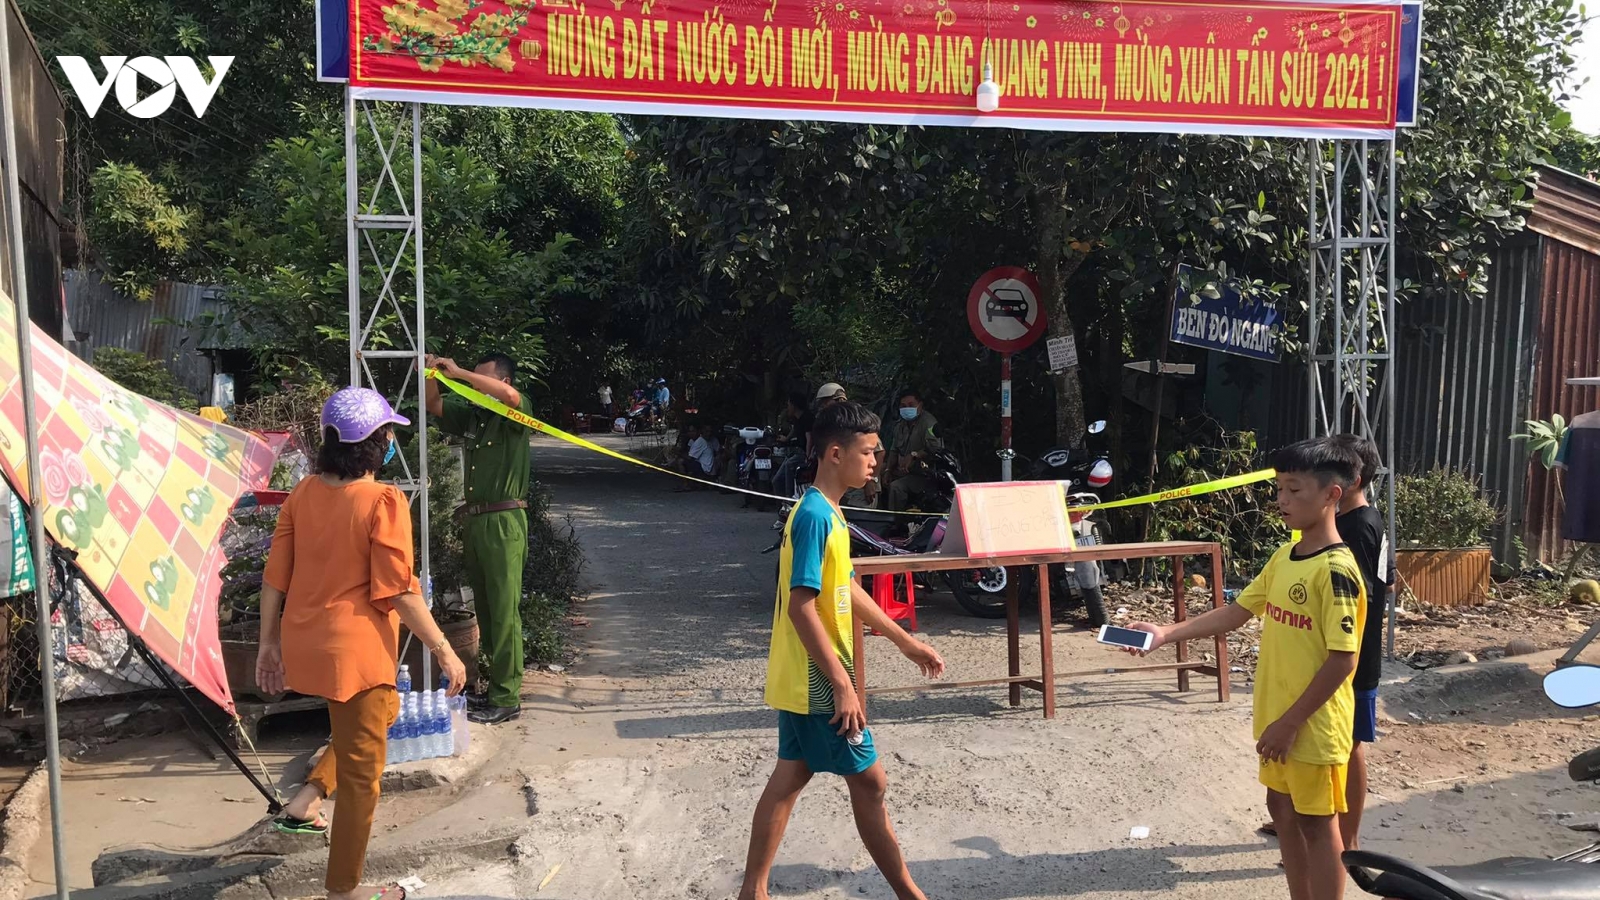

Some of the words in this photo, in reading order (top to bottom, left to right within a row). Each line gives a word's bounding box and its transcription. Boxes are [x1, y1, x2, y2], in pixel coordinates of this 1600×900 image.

[547, 0, 616, 79] MỪNG
[677, 6, 738, 85] NƯỚC
[745, 0, 783, 87] ĐỔI
[791, 12, 839, 102] MỚI,
[847, 15, 910, 93] MỪNG
[916, 11, 974, 96] ĐẢNG
[1055, 41, 1108, 113] VINH,
[1114, 28, 1173, 103] MỪNG
[1178, 31, 1231, 105] XUÂN
[1236, 34, 1276, 106] TÂN
[1279, 29, 1319, 108] SỬU
[1323, 52, 1370, 109] 2021
[1208, 307, 1230, 344] ĐÒ
[506, 409, 544, 431] POLICE
[1160, 488, 1191, 500] POLICE
